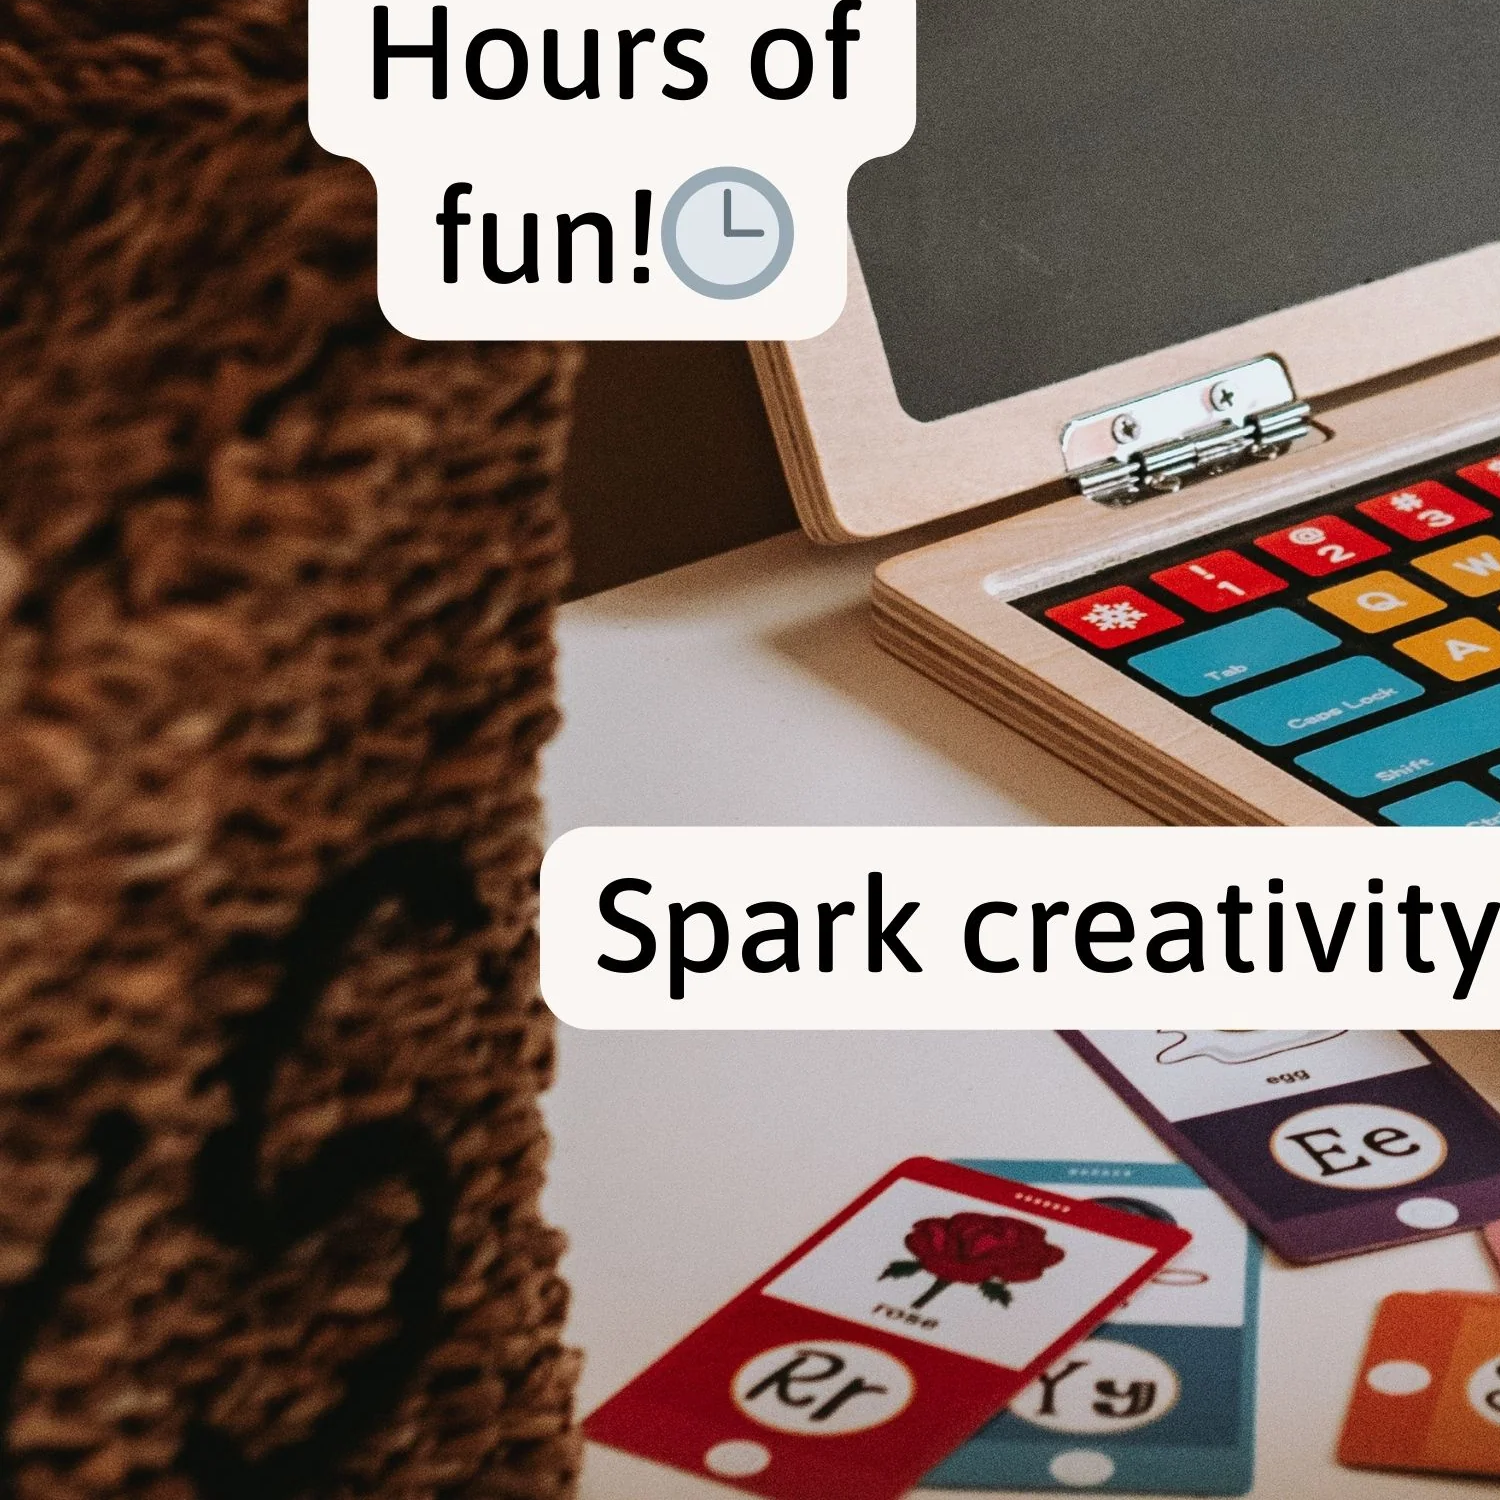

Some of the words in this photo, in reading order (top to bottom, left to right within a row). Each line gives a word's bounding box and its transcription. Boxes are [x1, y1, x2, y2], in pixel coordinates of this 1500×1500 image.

[1356, 590, 1407, 612] Q
[1445, 638, 1490, 662] A
[1203, 664, 1249, 681] Tab
[1286, 707, 1343, 730] Caps
[1341, 687, 1398, 710] Lock
[1374, 757, 1435, 783] Shift
[1266, 1068, 1310, 1087] egg
[1286, 1126, 1420, 1177] Ee
[872, 1303, 938, 1330] rose
[745, 1348, 888, 1422] Rr
[1038, 1359, 1157, 1418] Yy
